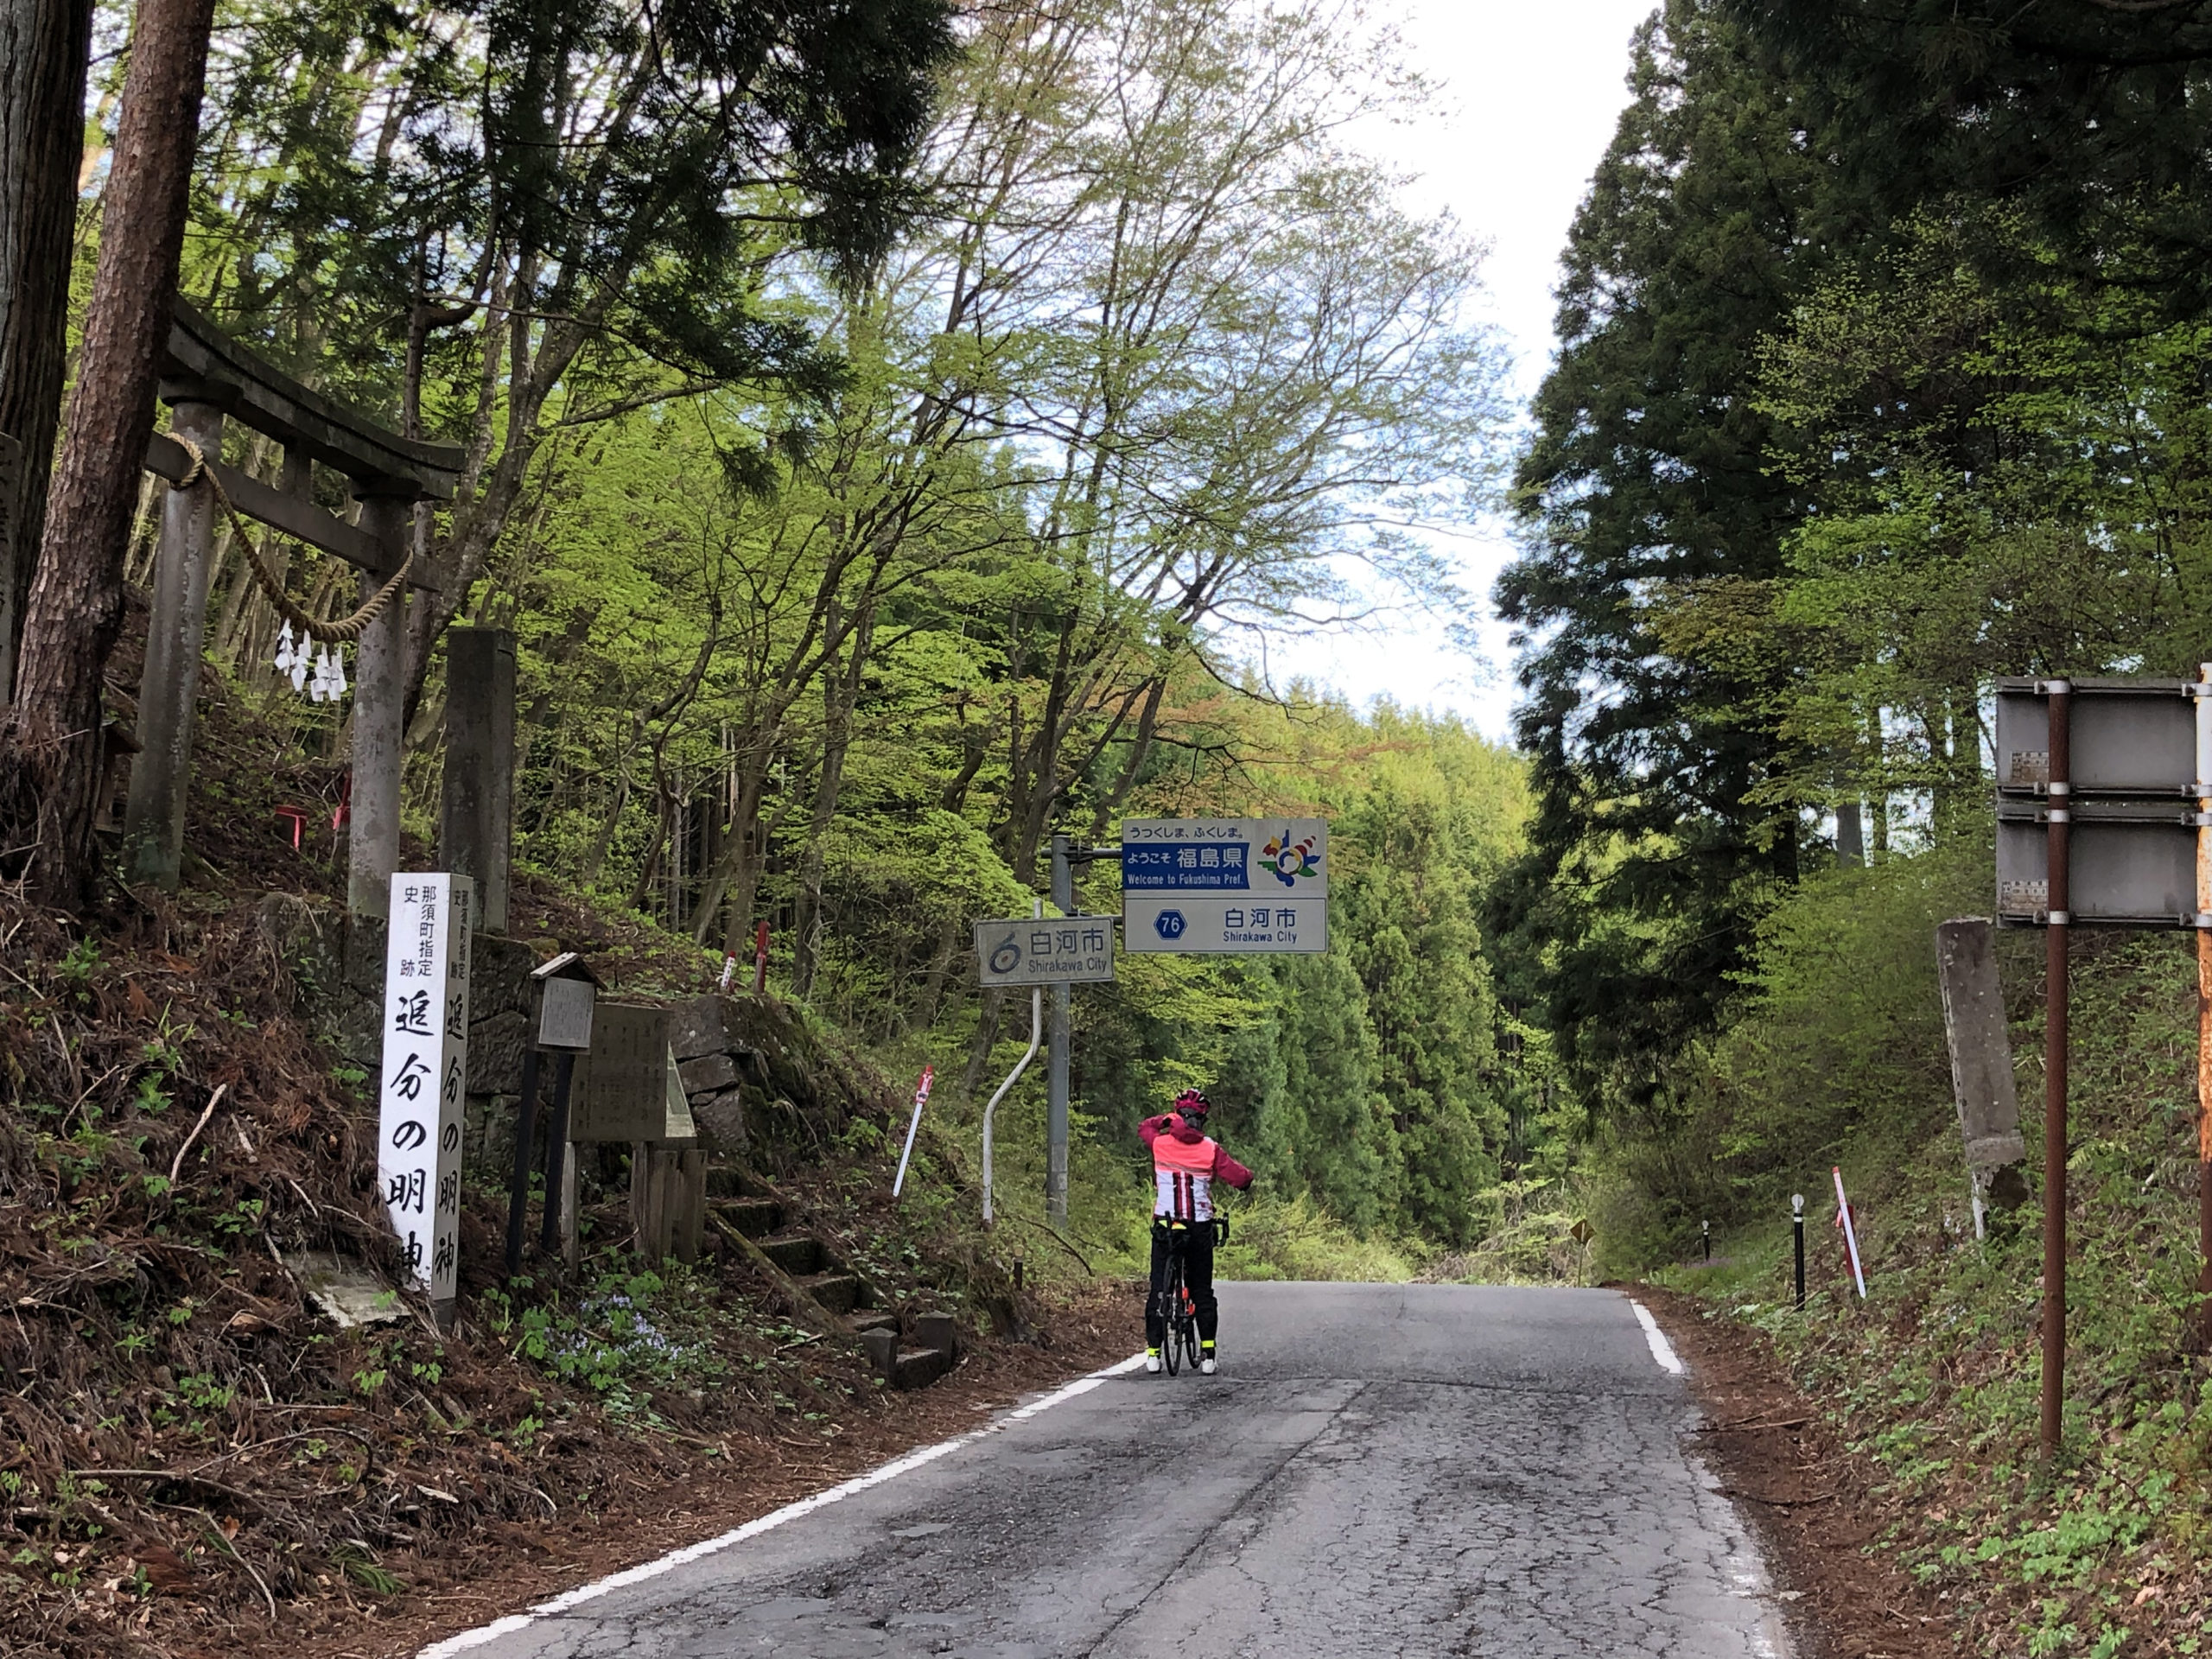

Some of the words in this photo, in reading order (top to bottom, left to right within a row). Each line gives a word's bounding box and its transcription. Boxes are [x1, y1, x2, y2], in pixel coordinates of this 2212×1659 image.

[1130, 827, 1243, 838] うつくしま、ふくしま。
[1128, 853, 1172, 864] ようこそ
[1177, 848, 1243, 868] 福島県
[1128, 874, 1164, 885] Welcome
[1167, 874, 1176, 885] to
[1179, 874, 1221, 885] Fukushima
[1224, 874, 1243, 885] Pref.
[1161, 917, 1180, 932] 76
[1225, 908, 1296, 928] 白河市
[418, 886, 436, 976] 那須町指定
[1224, 931, 1273, 942] Shirakawa
[1277, 931, 1297, 944] City
[1031, 927, 1103, 955] 白河市
[1028, 959, 1083, 973] Shirakawa
[1087, 957, 1107, 973] City
[435, 994, 464, 1284] 追分の明神
